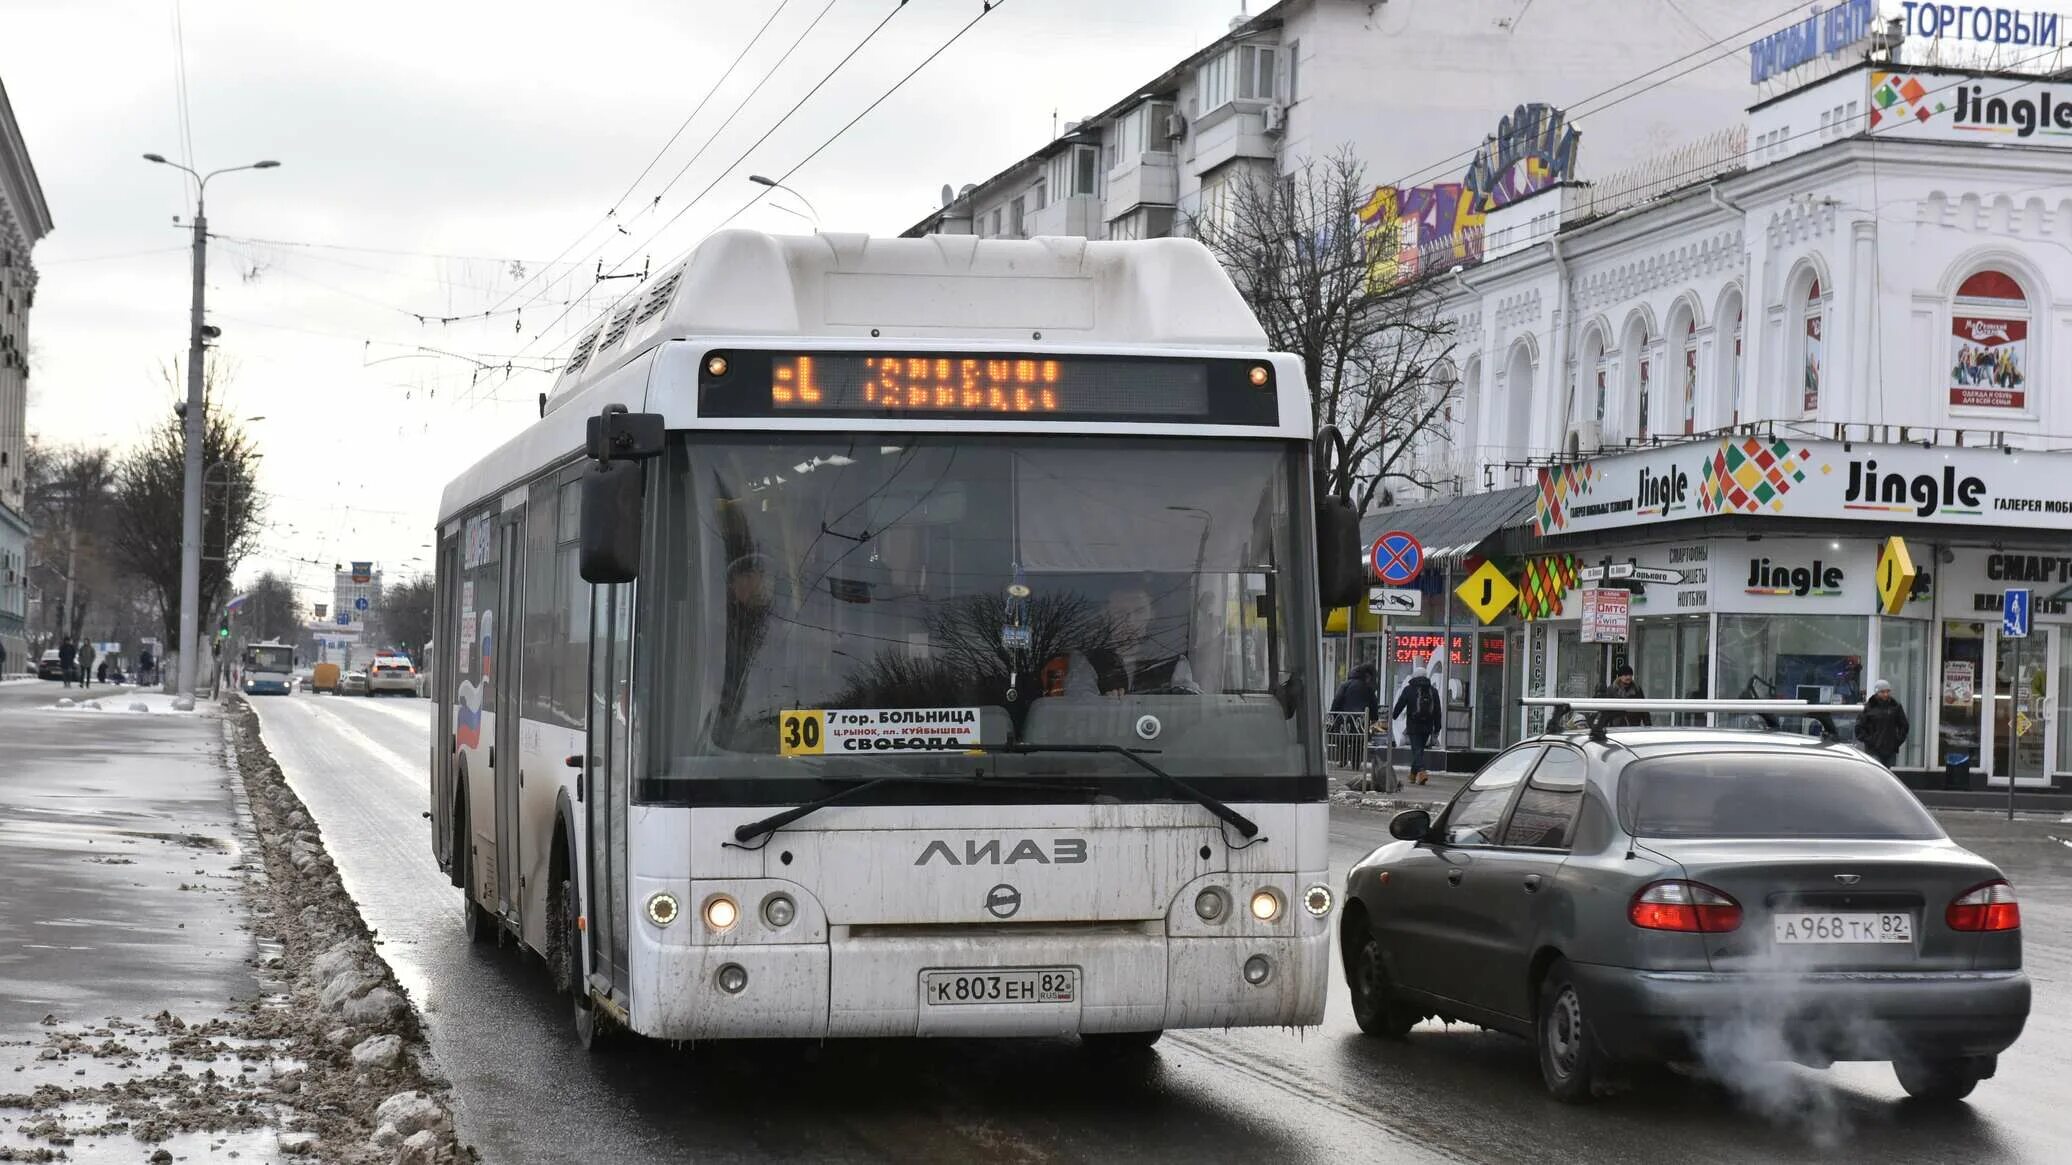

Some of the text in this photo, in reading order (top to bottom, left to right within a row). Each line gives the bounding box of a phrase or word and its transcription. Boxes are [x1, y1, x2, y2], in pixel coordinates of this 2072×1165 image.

[1954, 86, 2072, 136] Jingle
[1637, 464, 1687, 516] Jingle
[1845, 460, 1986, 517] Jingle
[1994, 498, 2042, 512] ГАЛЕРЕЯ
[1669, 545, 1708, 563] СМАРТФОНЫ
[1748, 559, 1843, 596] Jingle
[1481, 579, 1492, 606] J
[1678, 590, 1707, 608] НОУТБУКИ
[1605, 605, 1626, 613] МТС
[1452, 637, 1462, 648] И
[827, 710, 975, 726] 7 гор. БОЛЬНИЦА
[784, 716, 820, 748] 30
[902, 727, 971, 736] КУЙБЫШЕВА
[843, 738, 960, 751] СВОБОДА
[914, 839, 1087, 865] ЛИАЗ
[1881, 915, 1903, 932] 82
[1042, 974, 1066, 992] 82
[1040, 992, 1057, 1000] RUS
